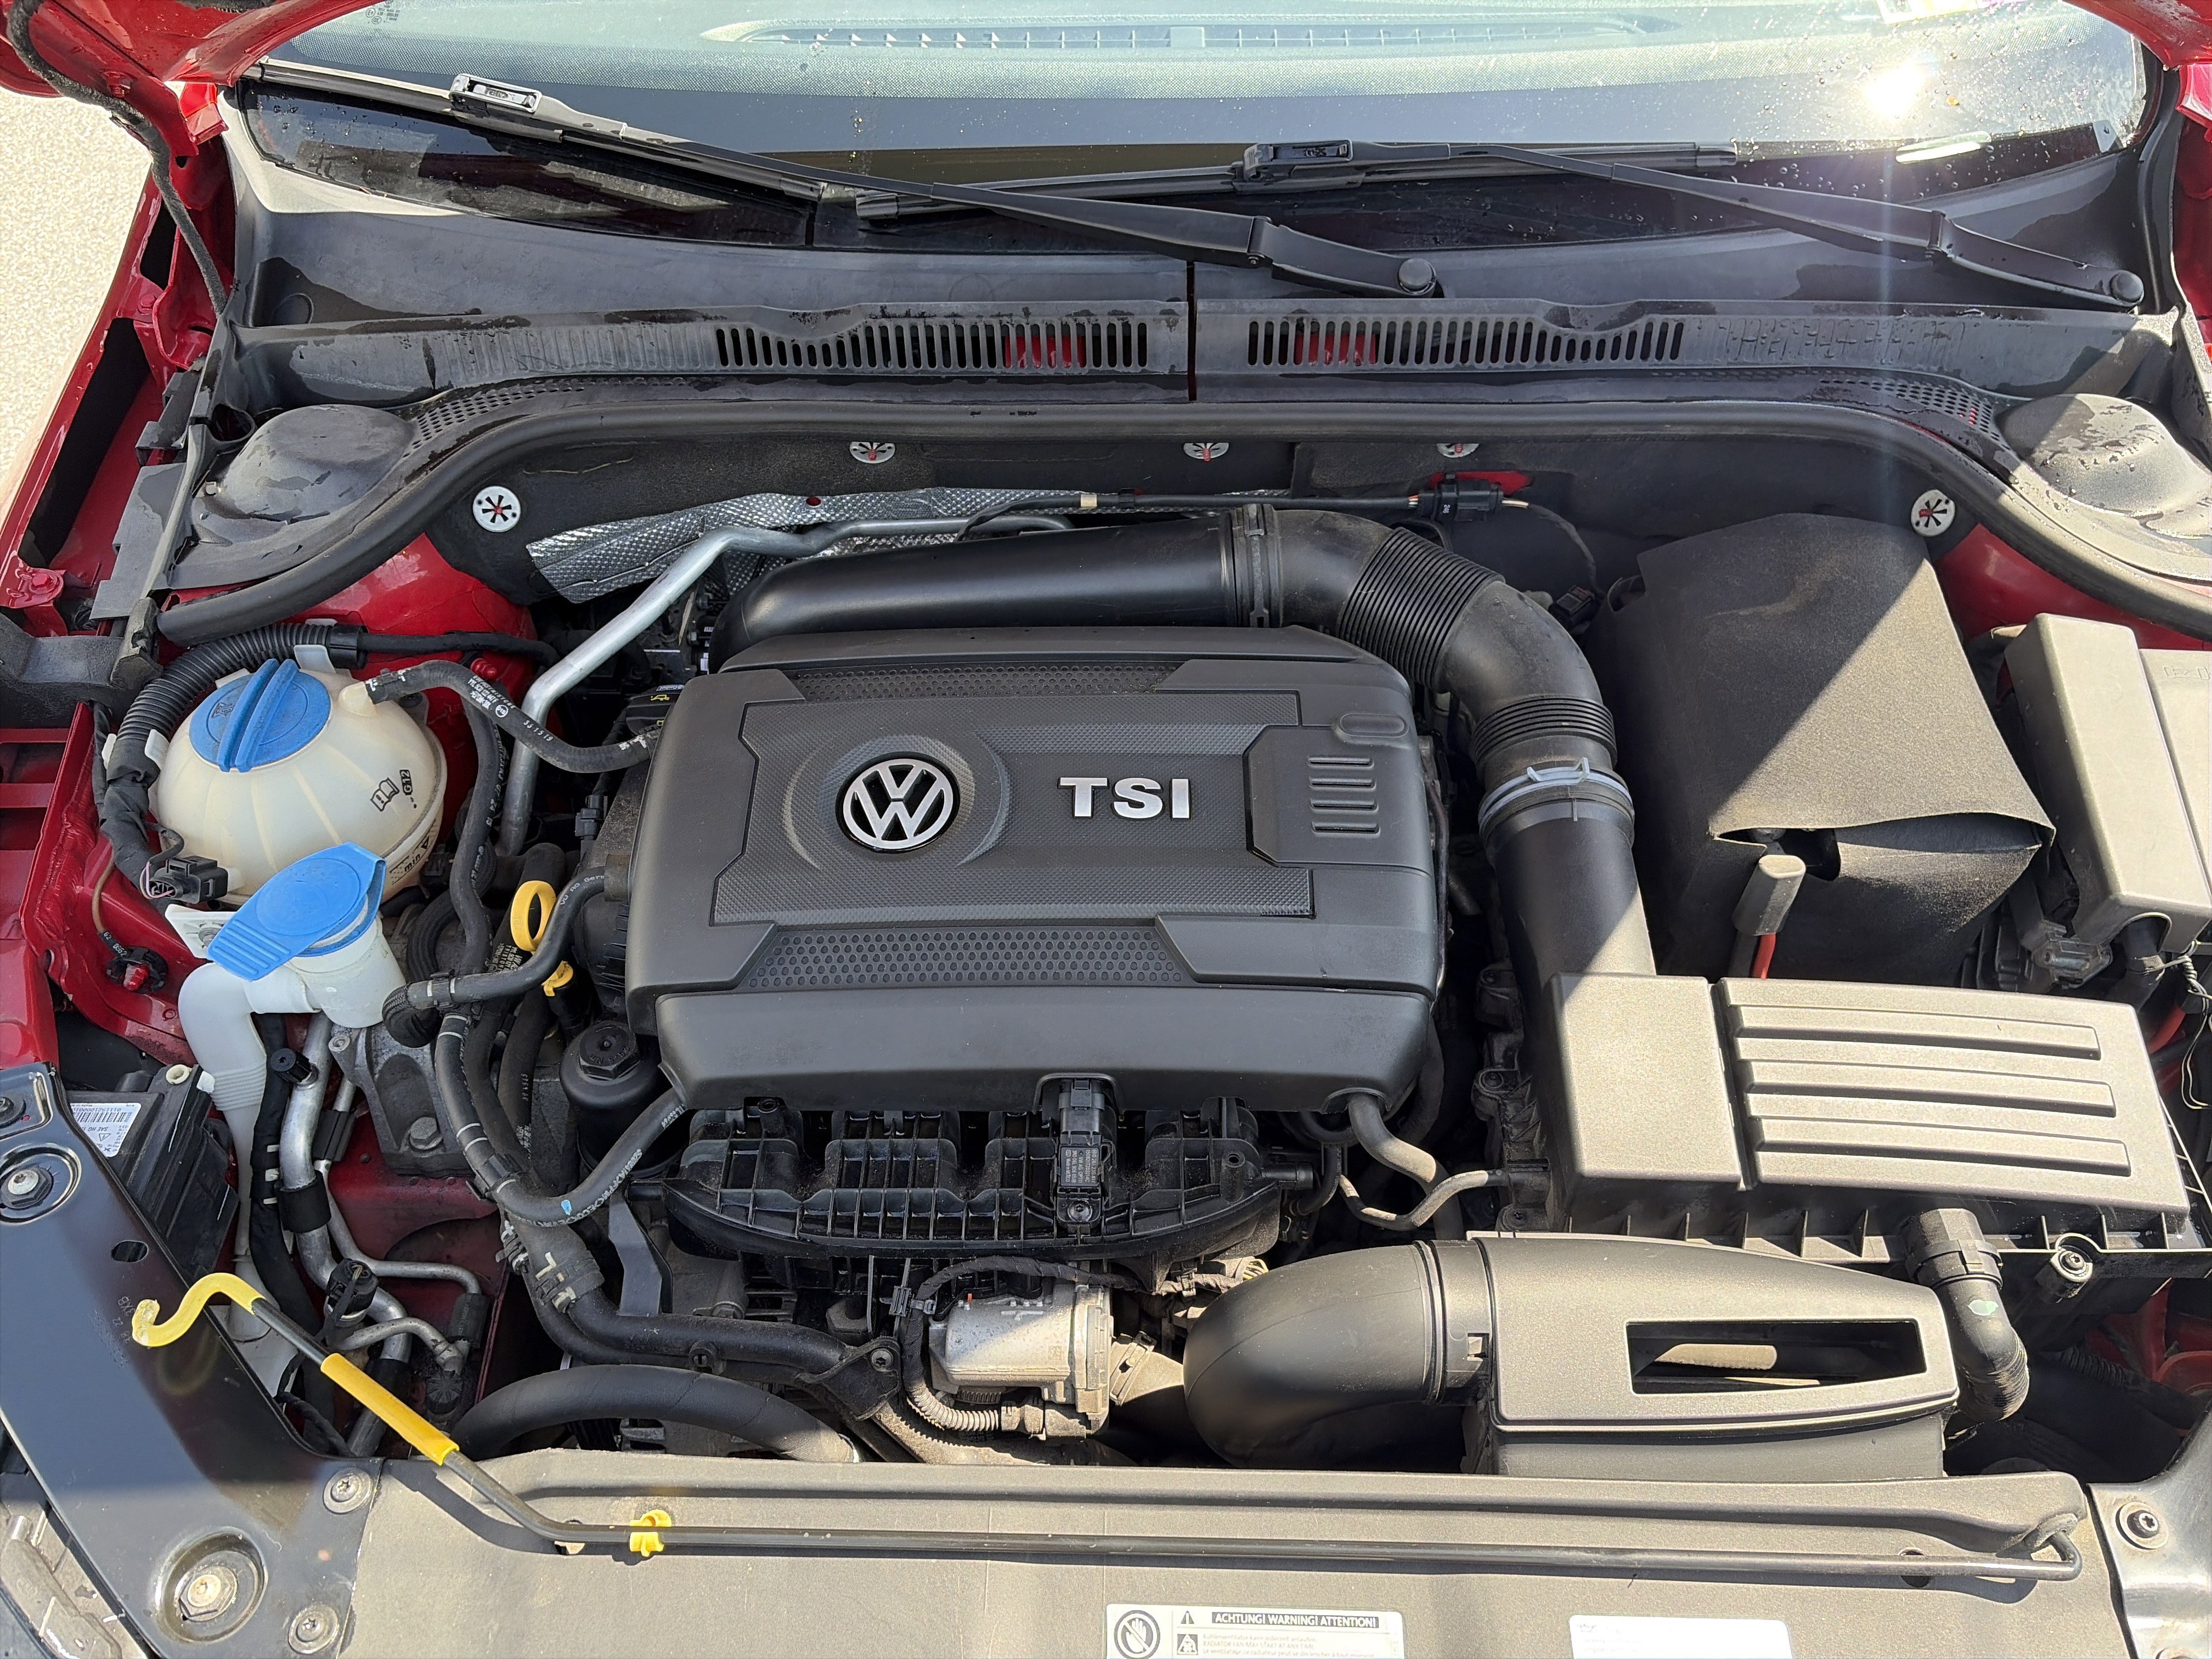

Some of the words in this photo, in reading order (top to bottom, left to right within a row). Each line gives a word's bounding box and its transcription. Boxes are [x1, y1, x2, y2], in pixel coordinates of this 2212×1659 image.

[1059, 776, 1192, 820] TSI
[405, 854, 421, 872] min
[1215, 1613, 1265, 1623] ACHTUNG!
[1267, 1615, 1318, 1625] WARNING!
[1321, 1616, 1376, 1628] ATTENTION!
